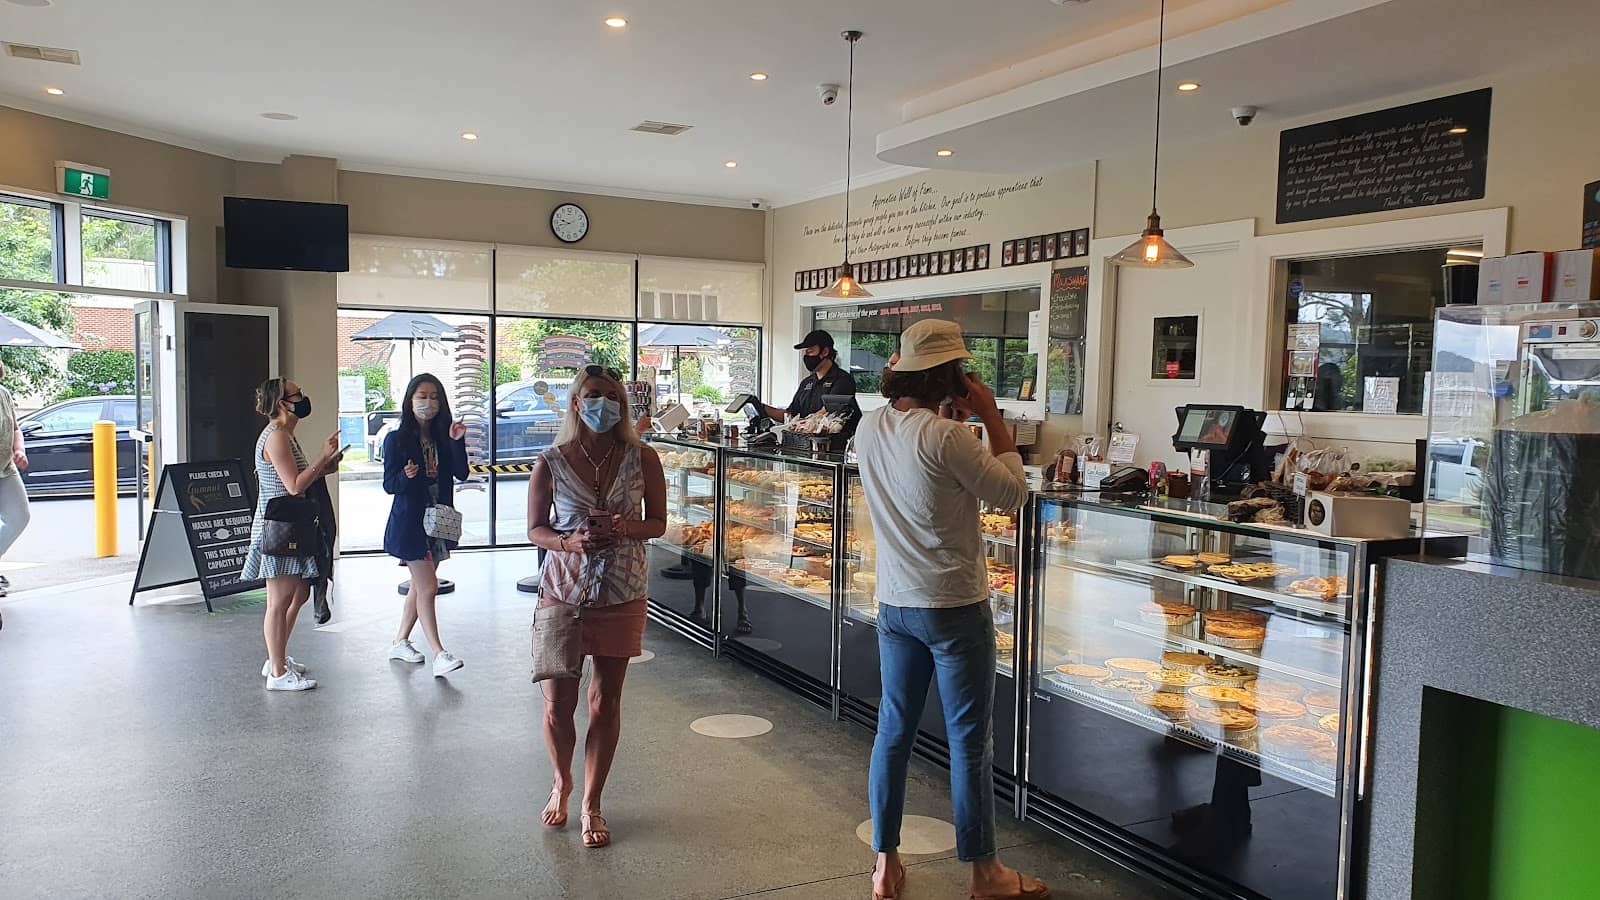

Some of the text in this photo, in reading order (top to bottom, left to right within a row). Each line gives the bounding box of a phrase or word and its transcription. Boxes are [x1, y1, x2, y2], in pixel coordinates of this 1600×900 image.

[1030, 176, 1043, 188] that
[868, 309, 878, 319] year
[189, 471, 207, 480] PLEASE
[208, 471, 223, 479] CHECK
[192, 516, 252, 530] MASKS ARE REQUIRED
[199, 526, 251, 540] FOR ENTRY
[204, 550, 218, 560] THIS
[219, 548, 236, 558] STORE
[208, 556, 243, 570] CAPACITY OF
